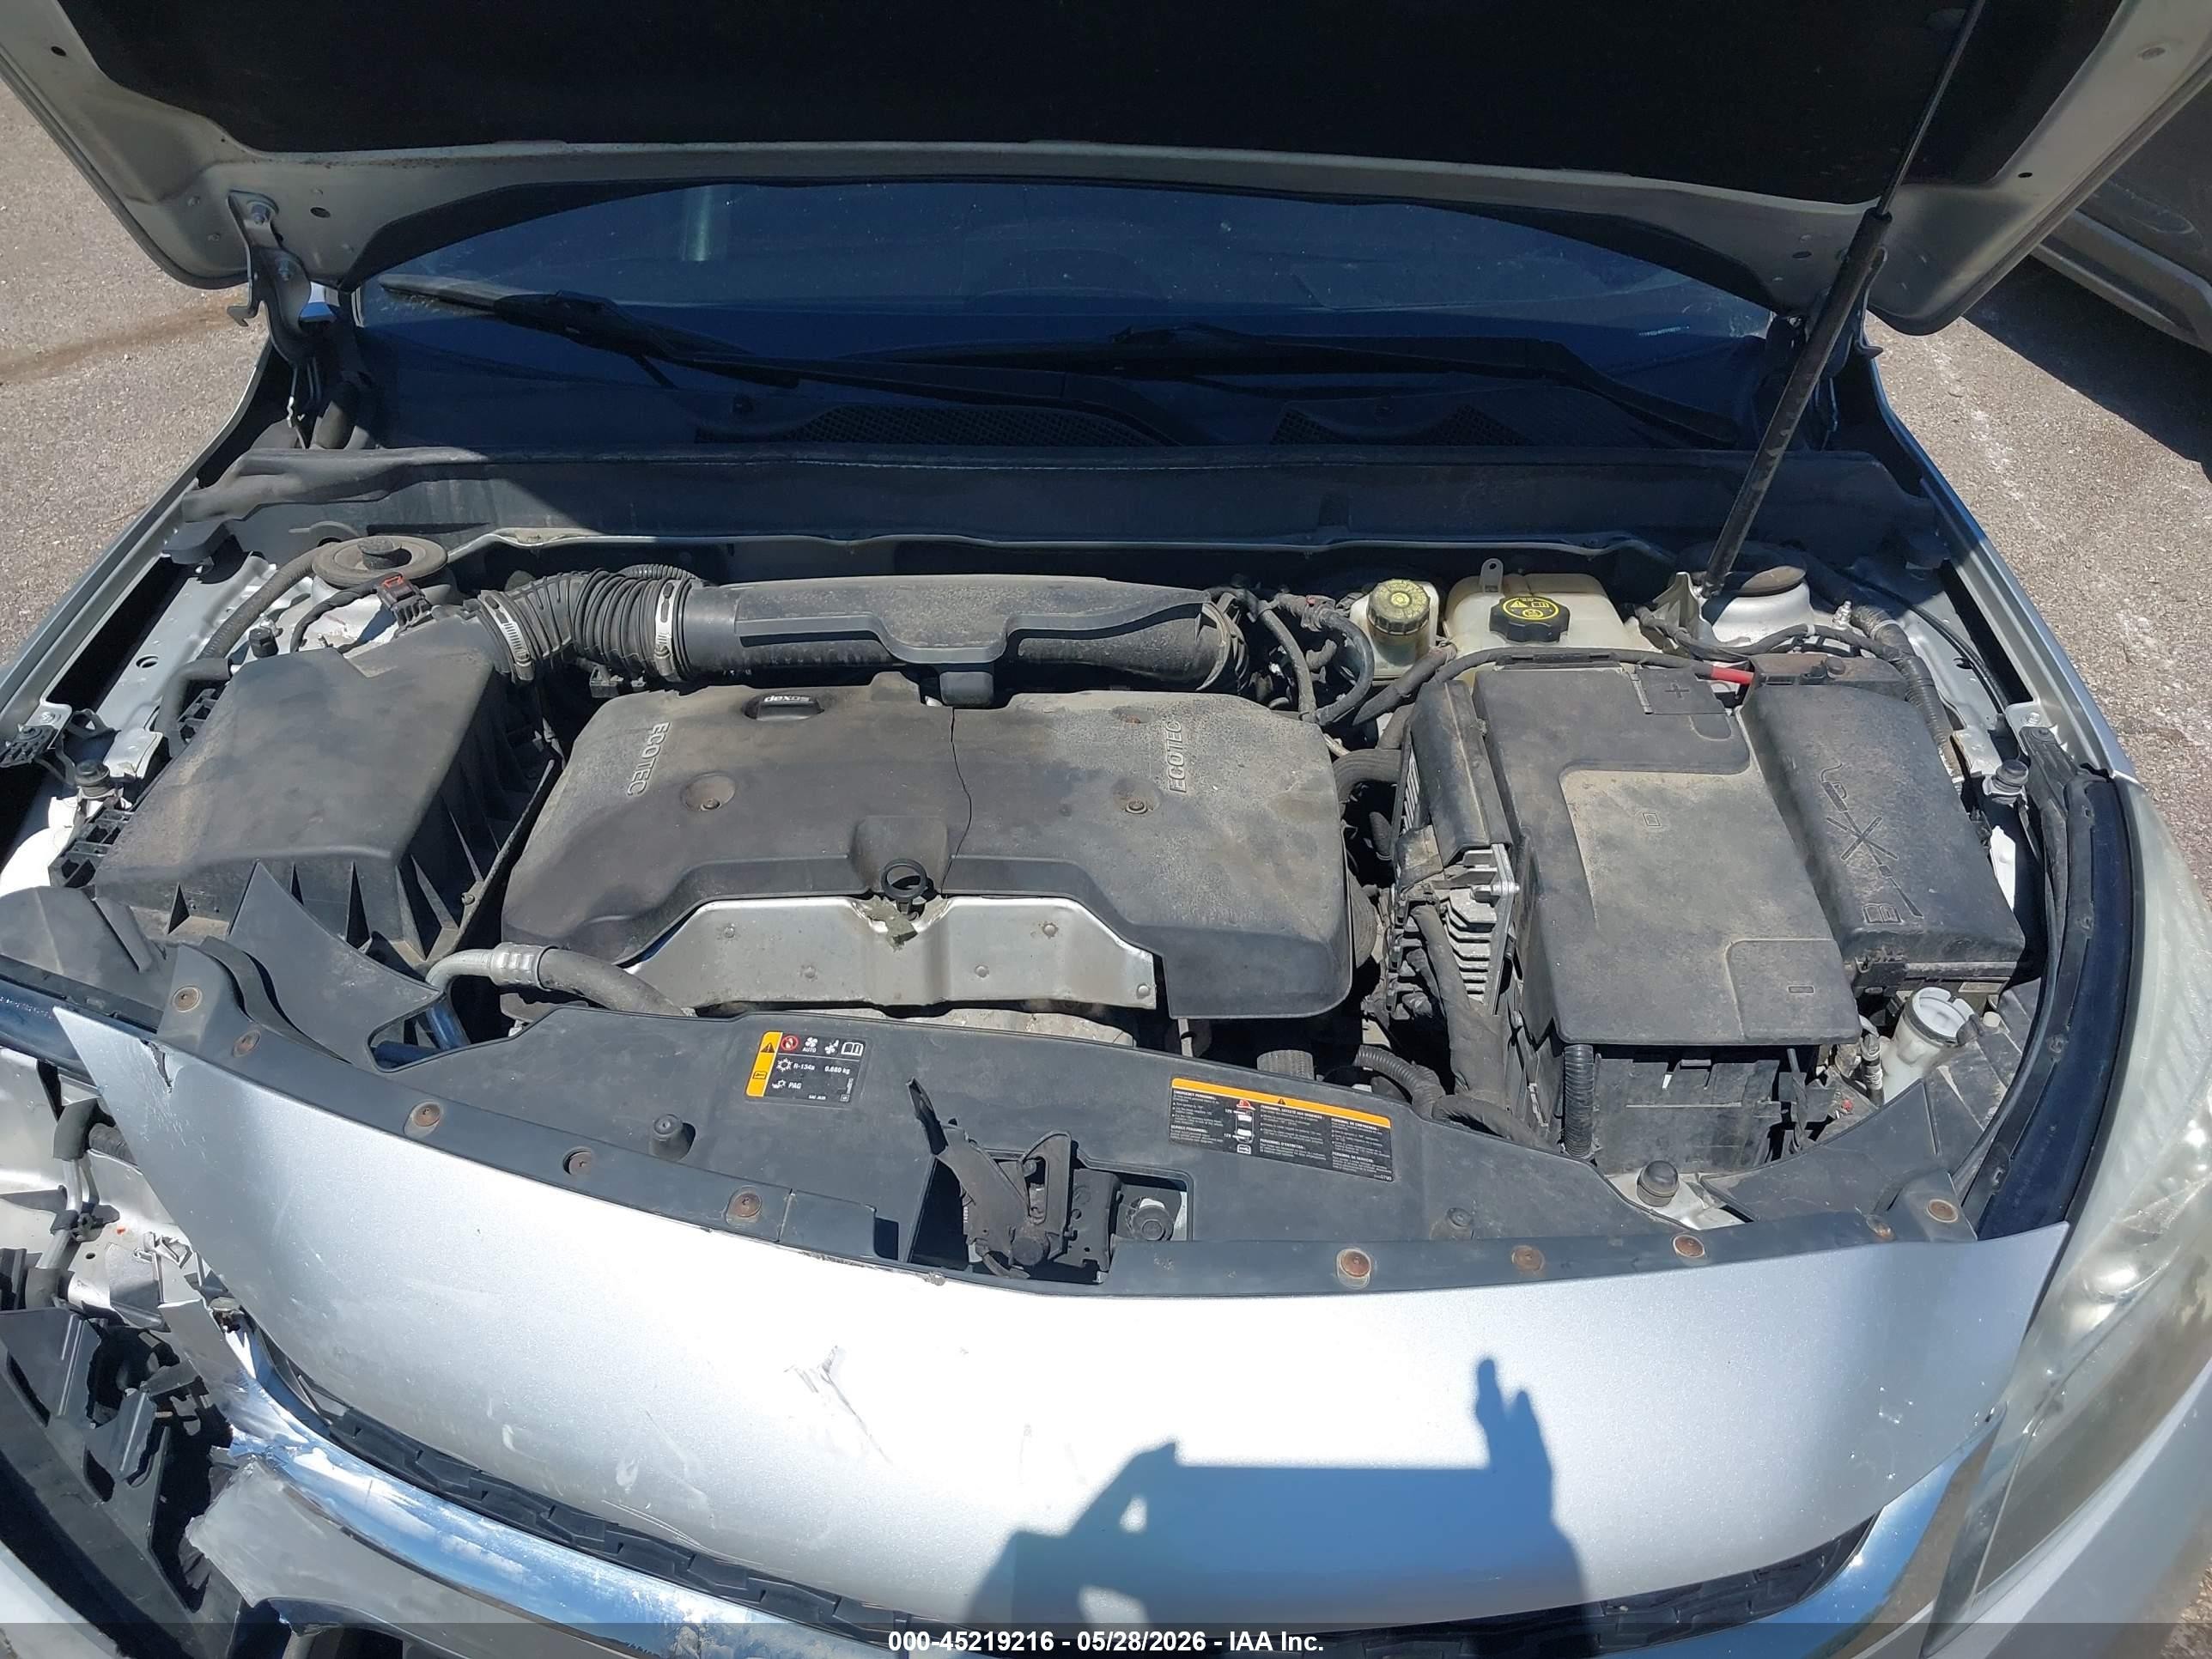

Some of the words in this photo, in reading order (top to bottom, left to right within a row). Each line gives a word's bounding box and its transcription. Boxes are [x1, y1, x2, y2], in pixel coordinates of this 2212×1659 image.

[763, 693, 811, 702] dexos
[627, 721, 671, 796] ECOTEC
[1165, 720, 1188, 793] ECOTEC
